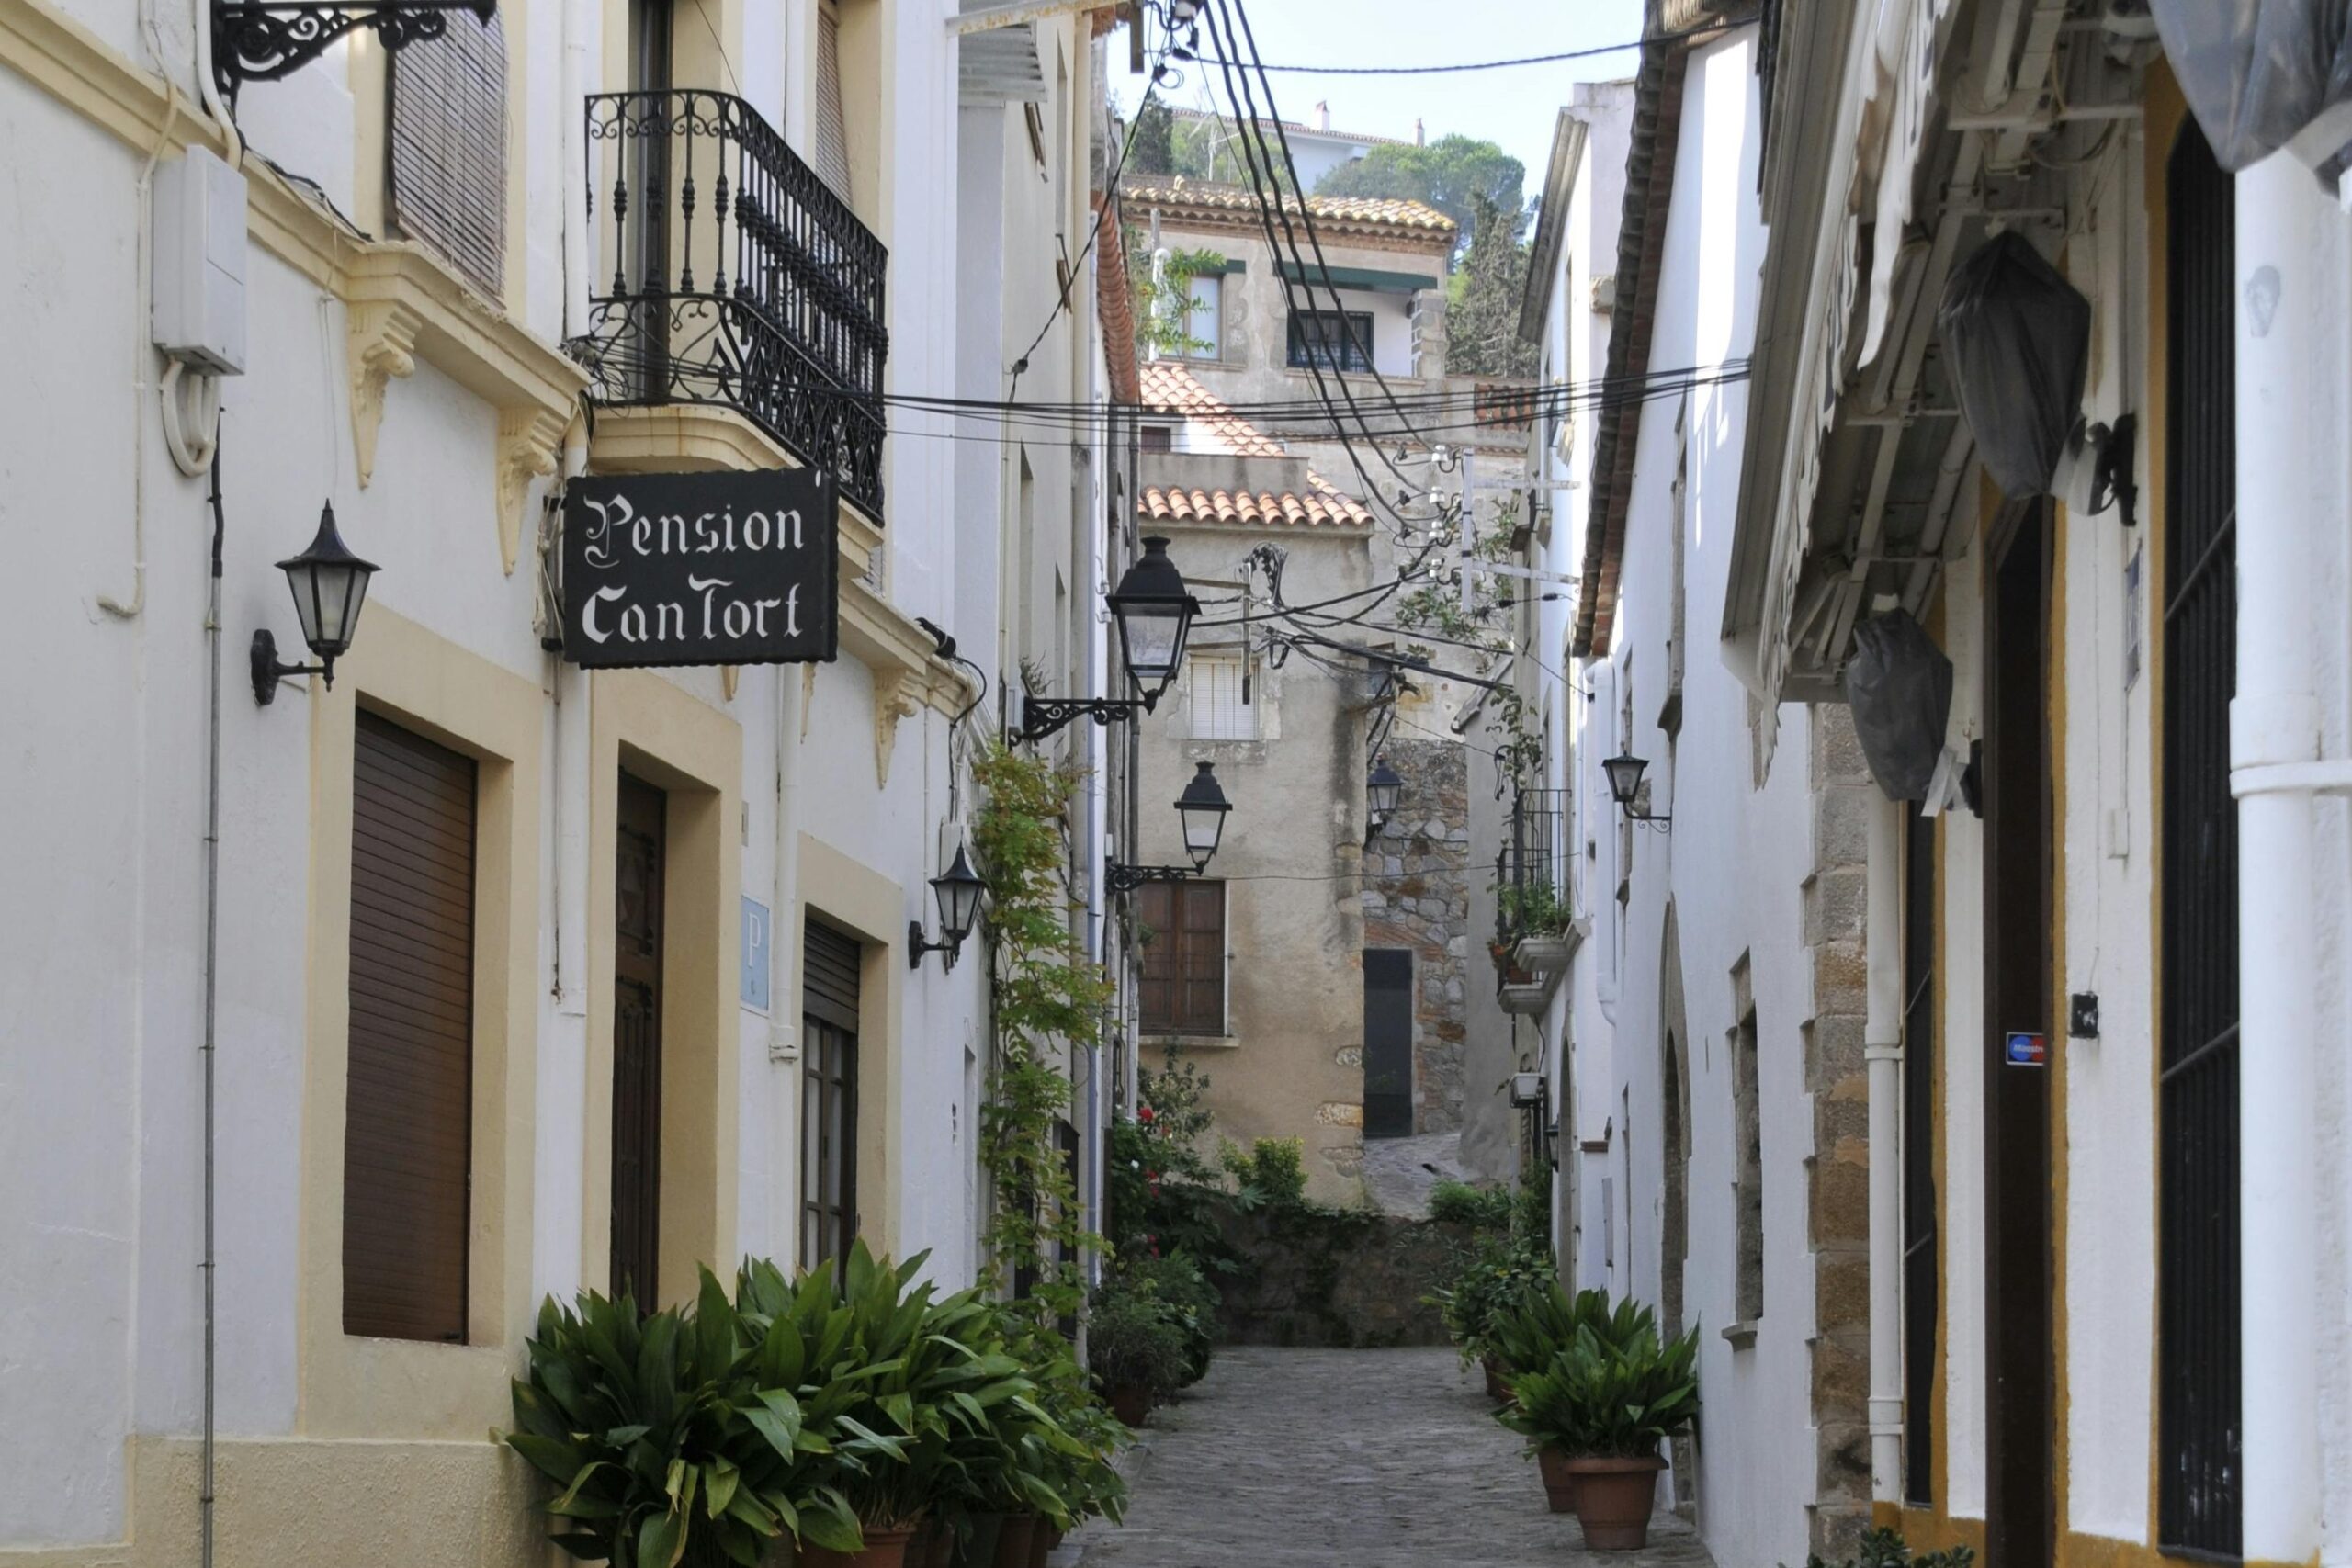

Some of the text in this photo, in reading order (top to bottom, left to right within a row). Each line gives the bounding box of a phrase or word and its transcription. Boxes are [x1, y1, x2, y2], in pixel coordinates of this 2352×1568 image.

[583, 493, 805, 569] Pension
[582, 572, 803, 644] Can Tort
[749, 912, 761, 969] P
